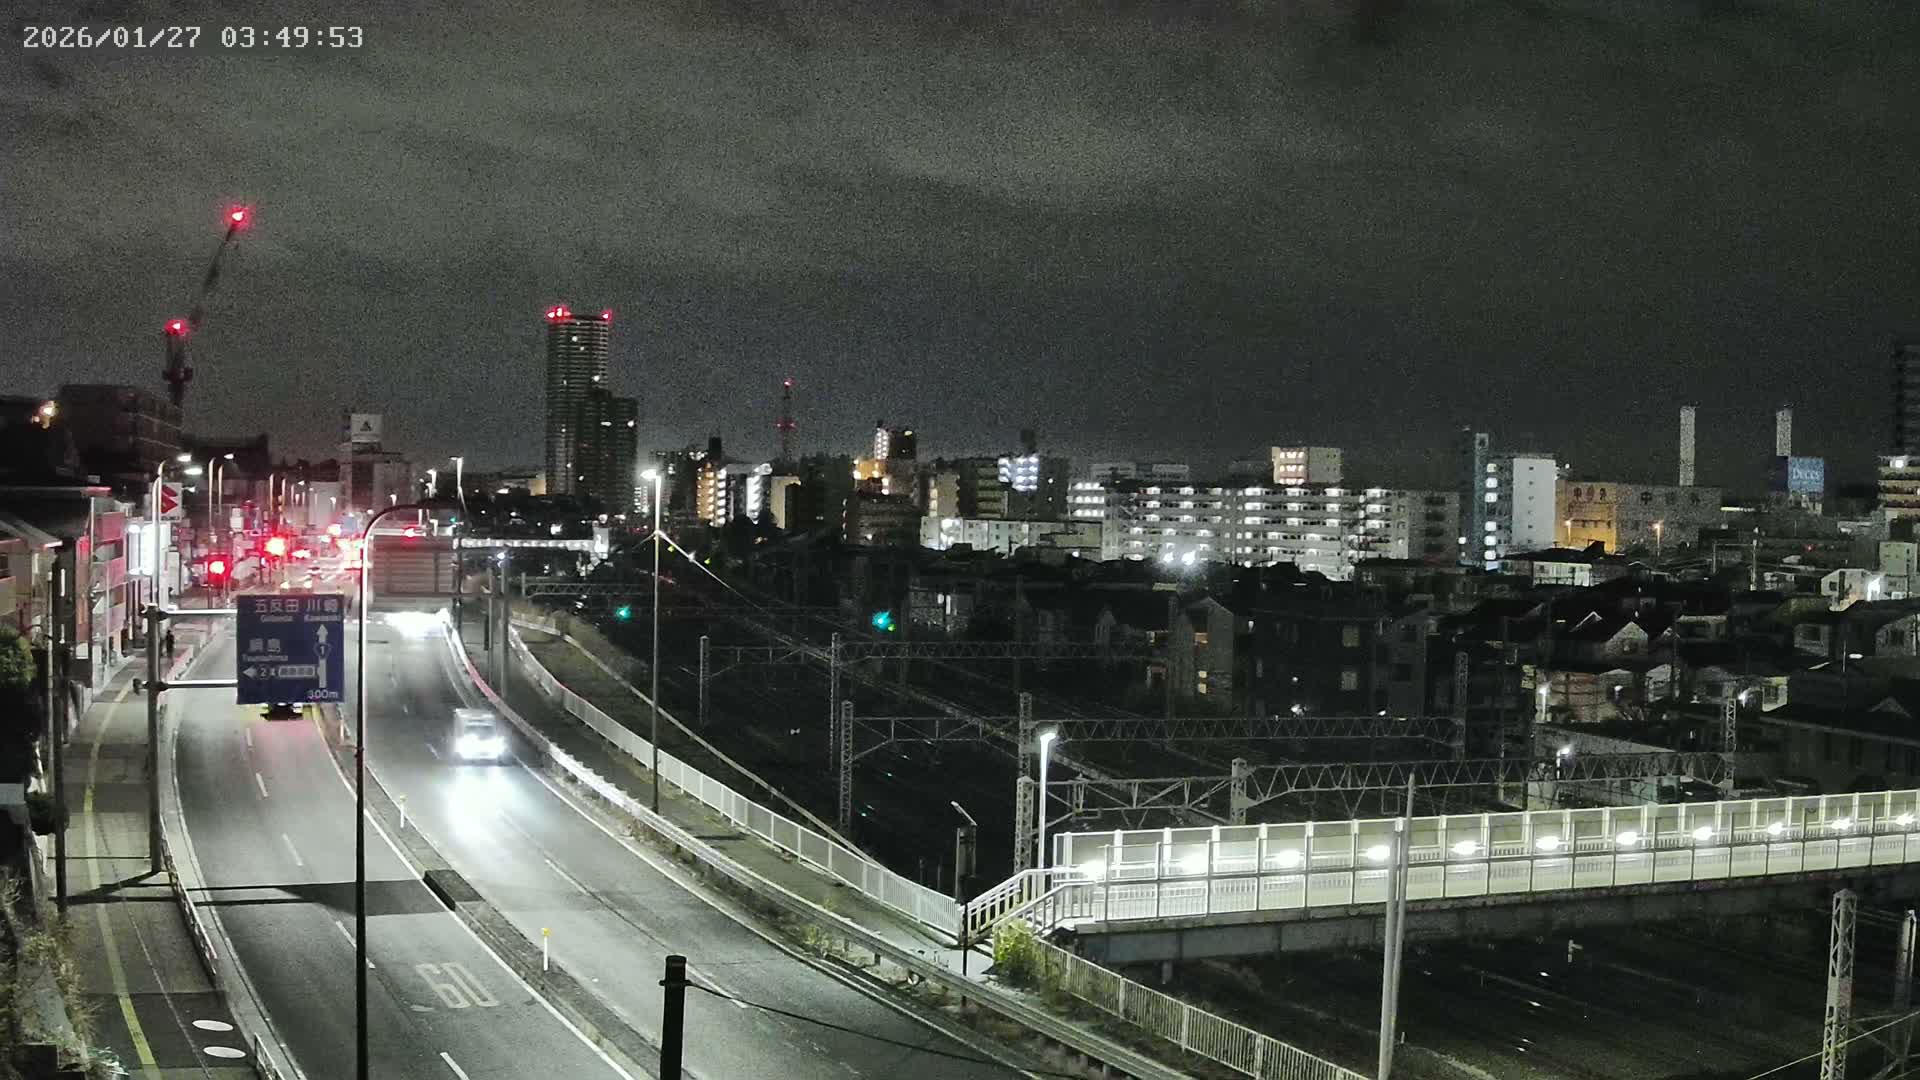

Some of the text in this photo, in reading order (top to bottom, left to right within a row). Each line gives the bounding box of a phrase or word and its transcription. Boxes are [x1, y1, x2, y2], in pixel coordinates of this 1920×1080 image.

[255, 599, 299, 613] 五反田
[307, 690, 338, 699] 300m
[415, 962, 500, 1009] 60
